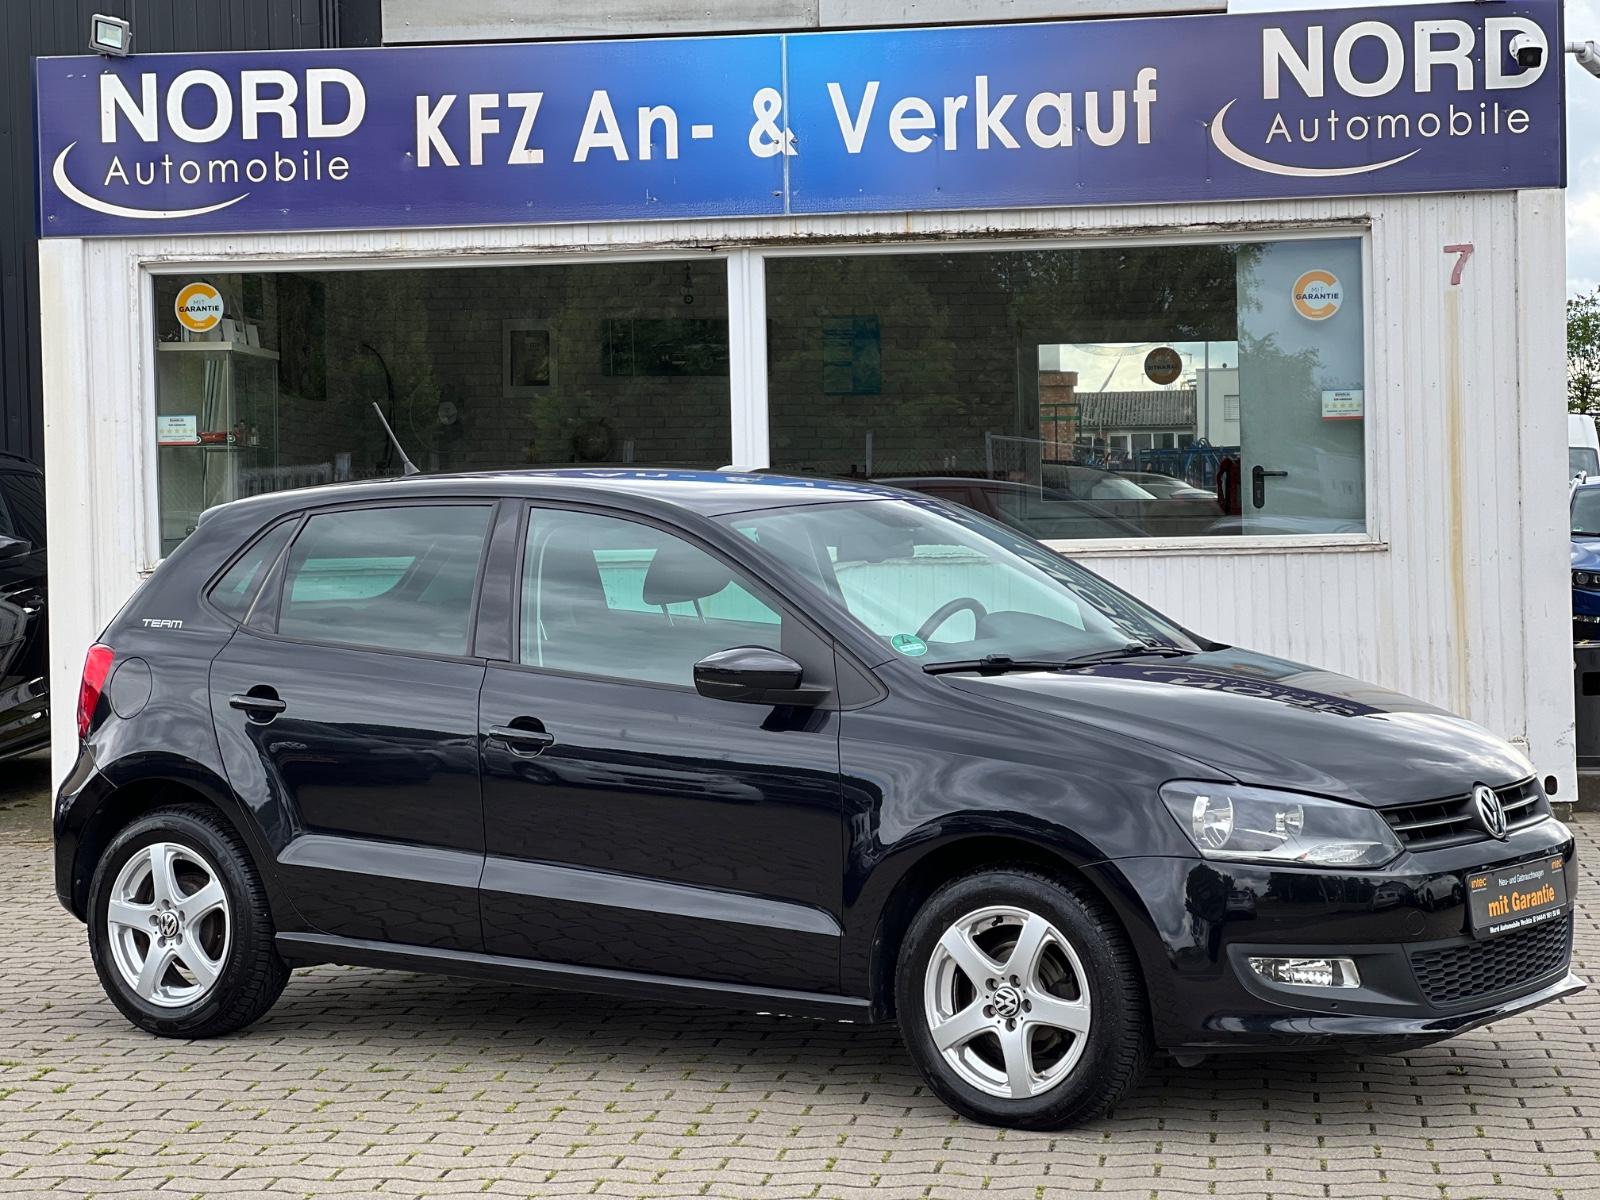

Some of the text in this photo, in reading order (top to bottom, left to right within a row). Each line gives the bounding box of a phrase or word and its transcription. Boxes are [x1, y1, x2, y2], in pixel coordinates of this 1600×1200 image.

[1262, 17, 1549, 100] NORD
[100, 67, 366, 143] NORD
[415, 67, 1158, 168] KFZ An- & Verkauf
[1265, 102, 1531, 145] Automobile
[104, 149, 350, 187] Automobile
[1443, 243, 1475, 286] 7
[178, 305, 220, 313] GARANTIE
[1295, 292, 1339, 300] GARANTIE
[142, 618, 183, 629] TEAM
[1508, 874, 1517, 885] und
[1488, 895, 1509, 917] mit
[1511, 883, 1555, 911] Garantie
